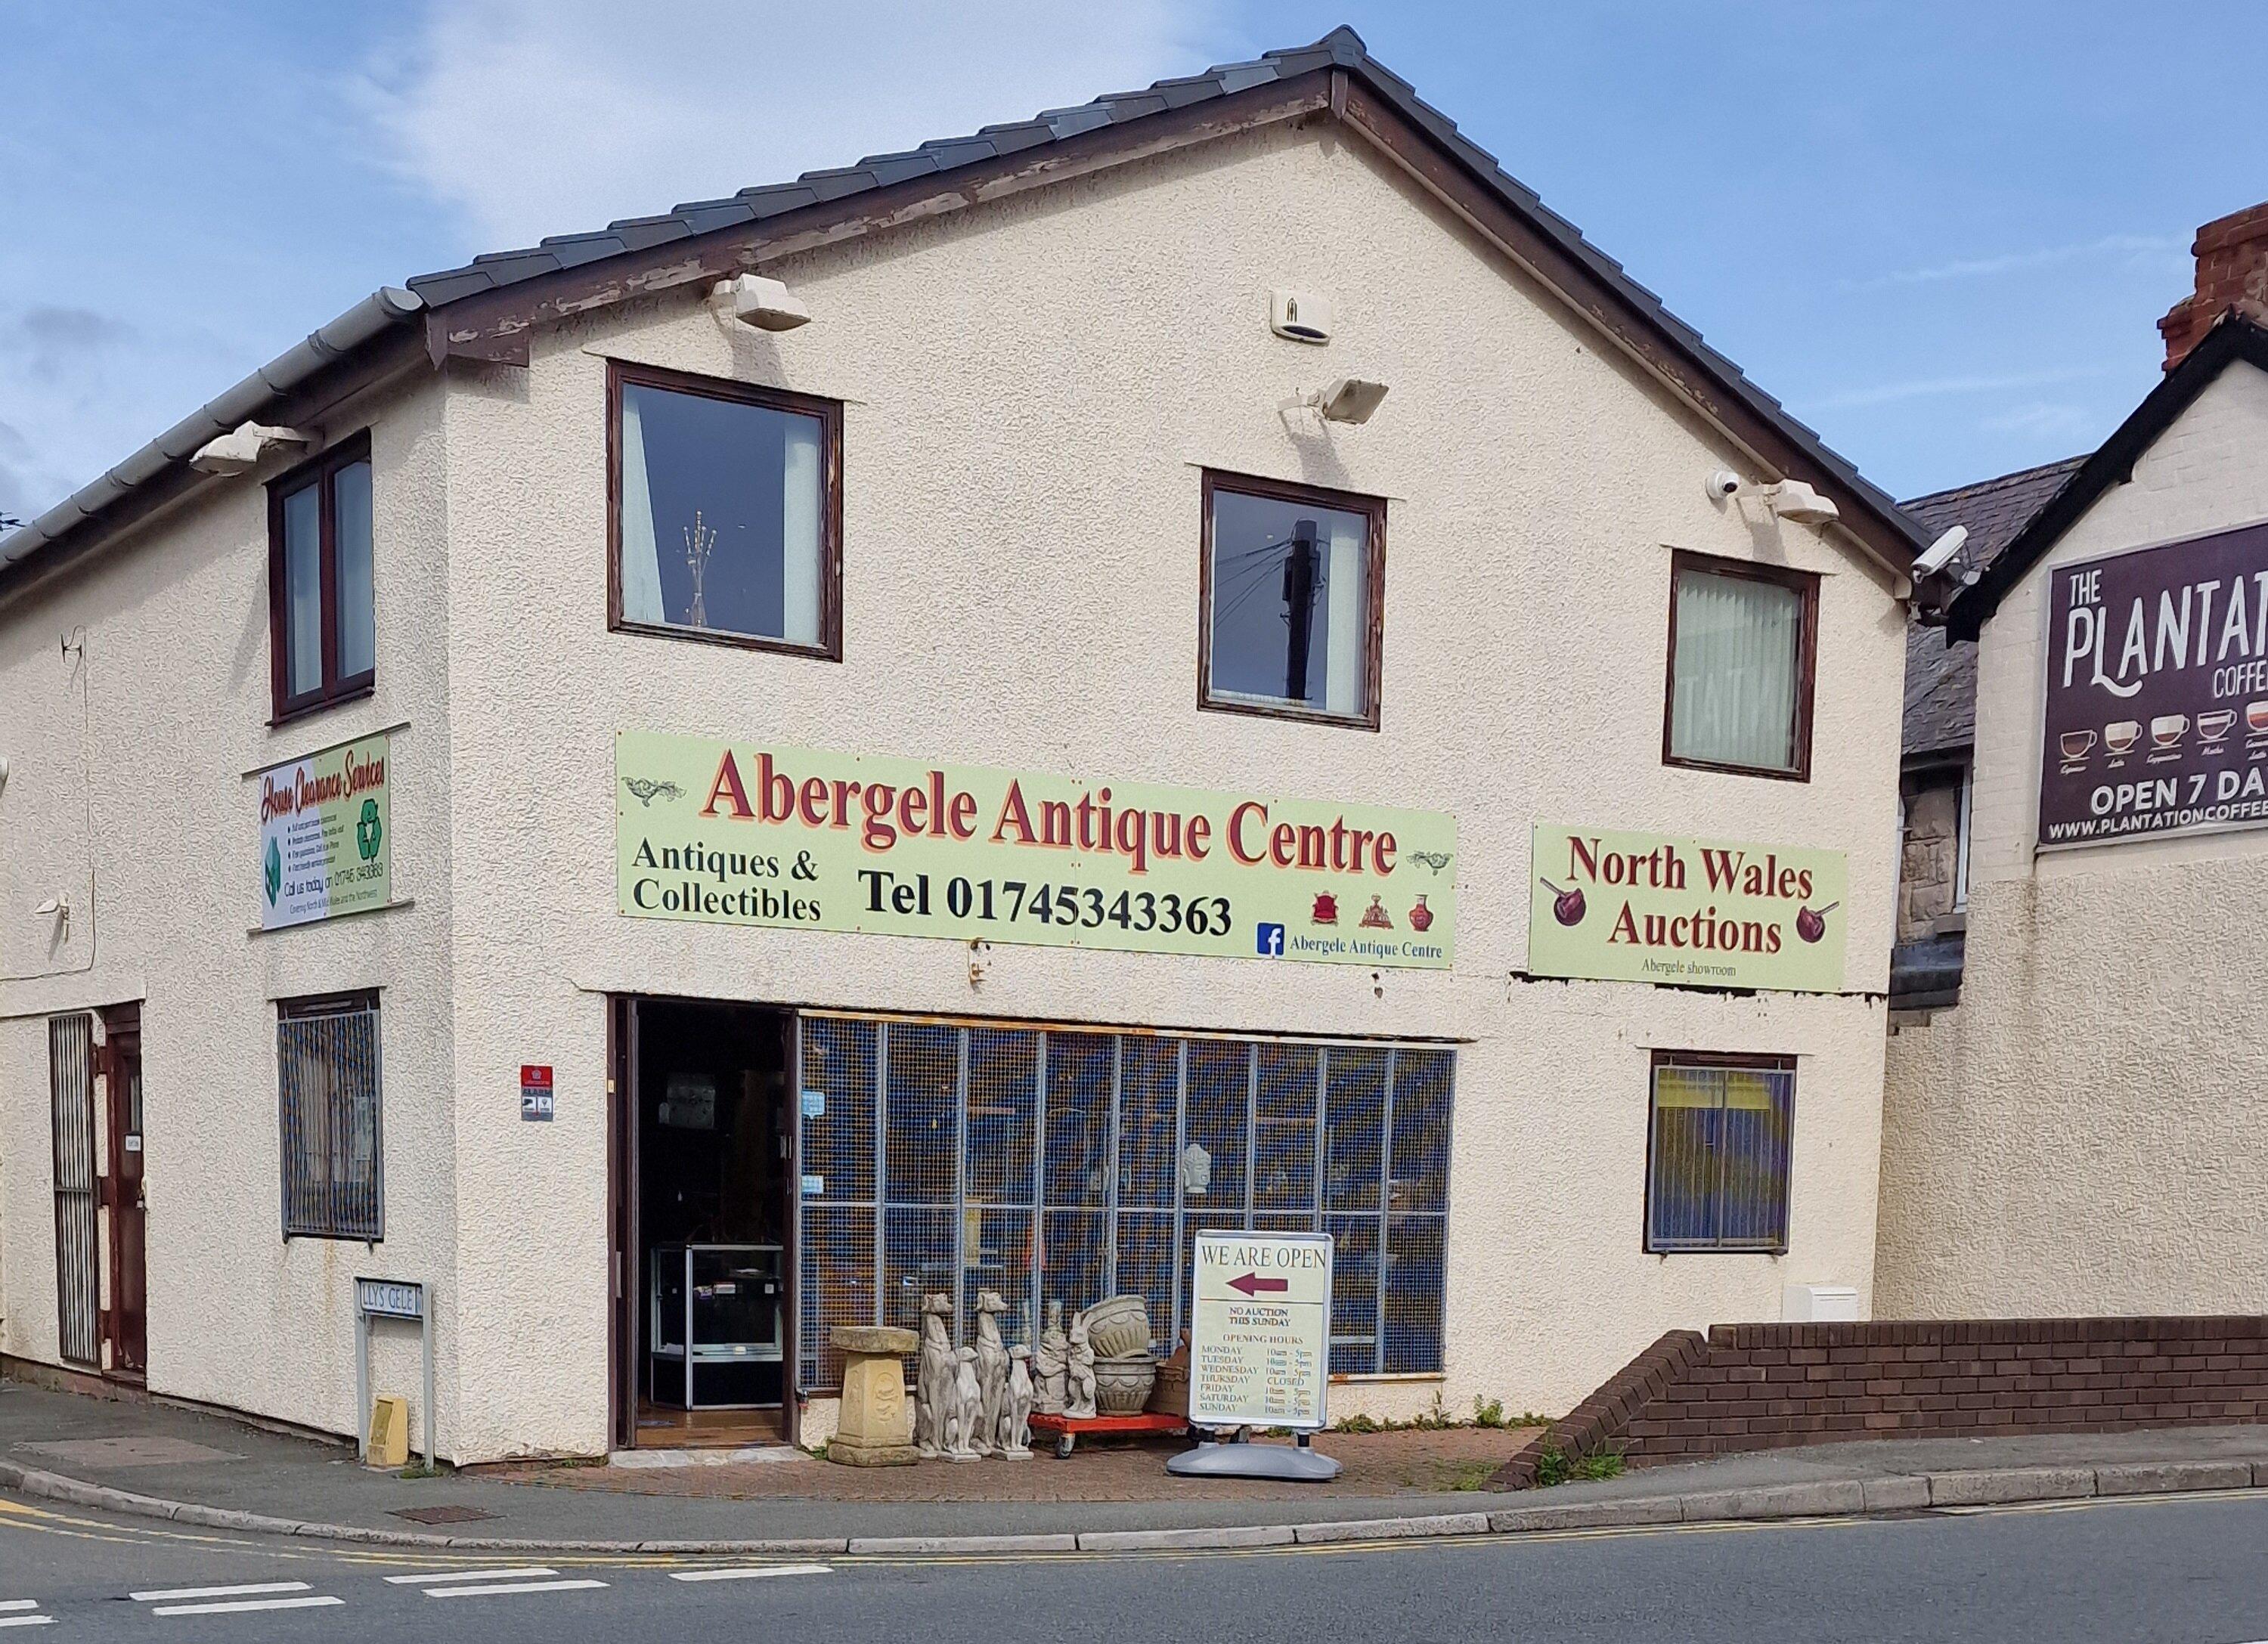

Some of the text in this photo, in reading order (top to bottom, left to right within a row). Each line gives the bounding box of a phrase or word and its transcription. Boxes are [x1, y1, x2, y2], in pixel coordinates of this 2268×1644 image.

[2069, 568, 2102, 606] THE
[2213, 659, 2268, 698] COFFE
[296, 766, 342, 816] Clearance
[343, 750, 384, 800] Services
[2090, 766, 2268, 816] OPEN 7 DA
[699, 748, 1399, 877] Abergele Antique Centre
[632, 837, 820, 883] Antiques &
[1566, 834, 1814, 901] North Wales
[633, 878, 821, 921] Collectibles
[858, 868, 1232, 936] Tel 01745343363
[1606, 899, 1782, 955] Auctions
[1290, 935, 1442, 958] Abergele Antique Centre
[1641, 958, 1737, 977] Abergele showroom
[1202, 1245, 1325, 1268] WE ARE OPEN
[362, 1283, 412, 1310] LLYS GELE
[1228, 1316, 1290, 1327] THIS SUNDAY
[1229, 1306, 1288, 1317] NO AUCTION
[1202, 1345, 1243, 1355] MONDAY
[1223, 1333, 1303, 1345] OPENING HOURS
[1201, 1355, 1244, 1364] TUESDAY
[1201, 1364, 1259, 1374] WEDNESDAY
[1201, 1374, 1304, 1385] THURSDAY CLOSED
[1201, 1383, 1235, 1392] FRIDAY
[1198, 1403, 1238, 1412] SUNDAY
[1199, 1393, 1249, 1402] SATURDAY
